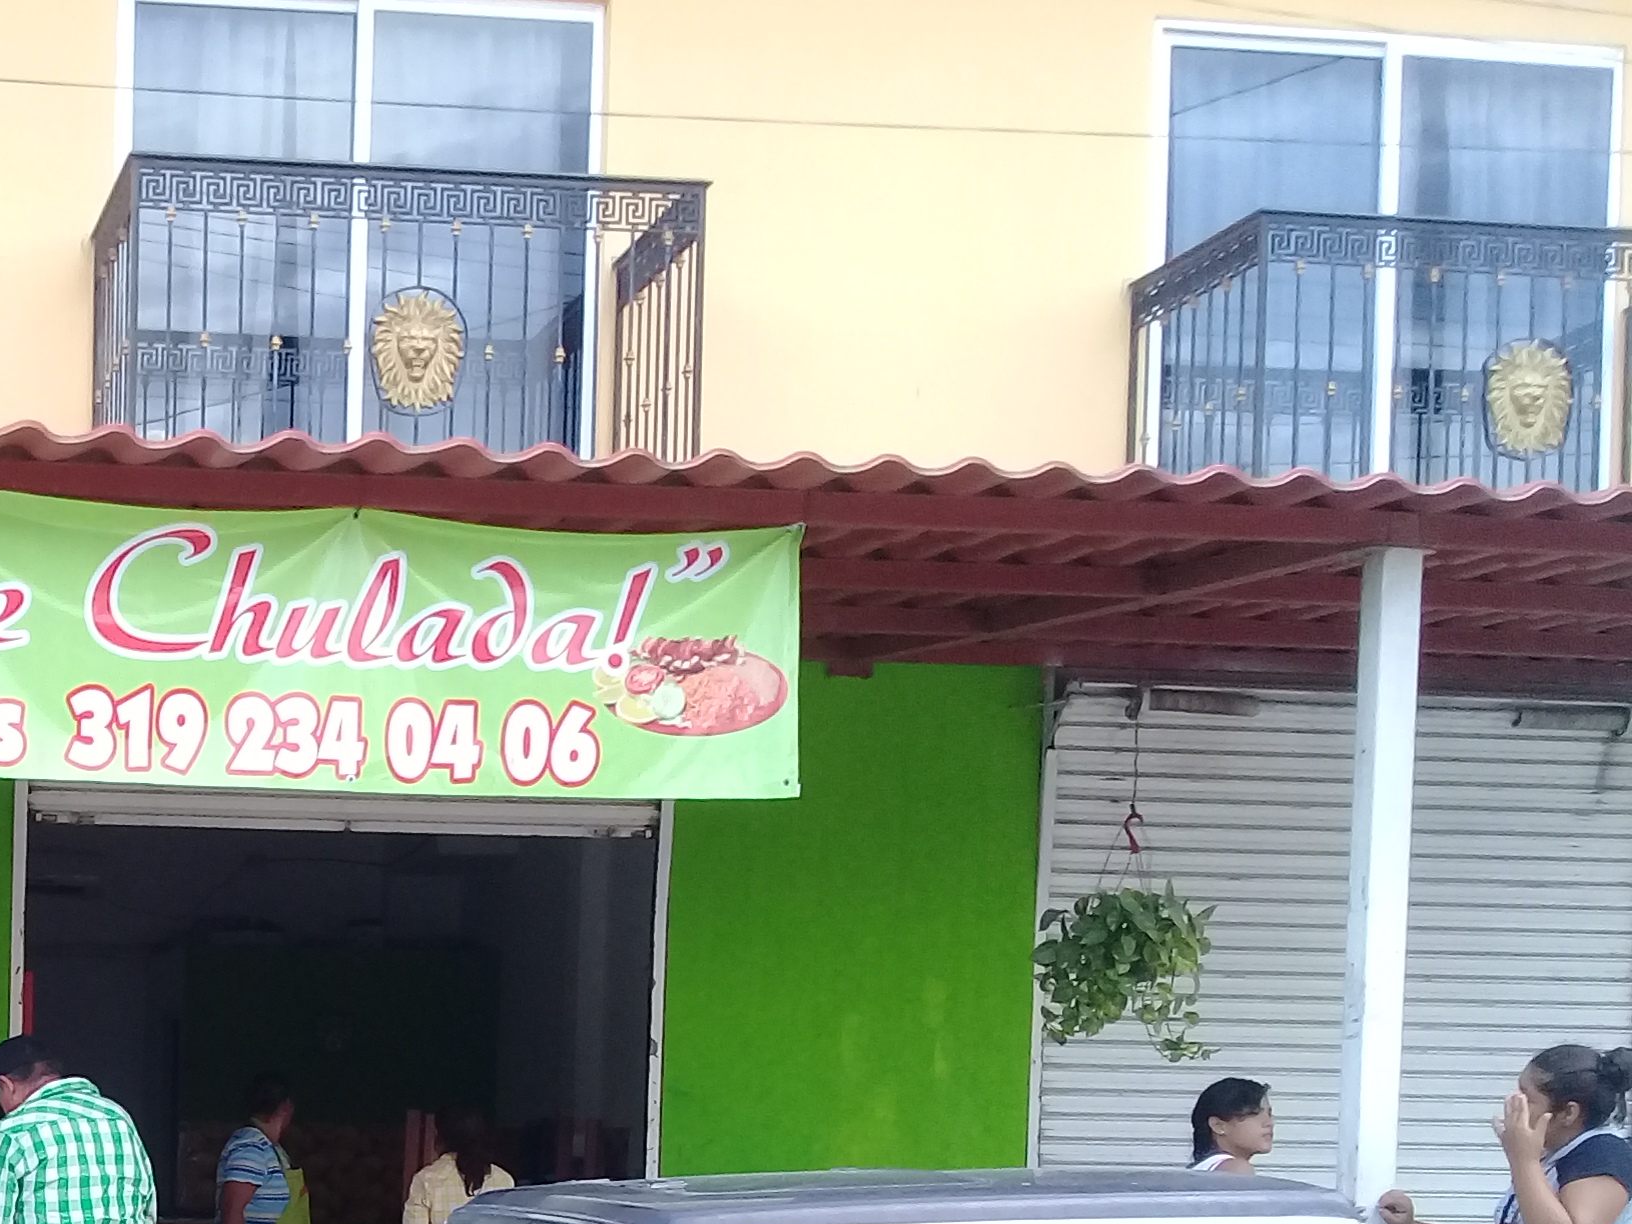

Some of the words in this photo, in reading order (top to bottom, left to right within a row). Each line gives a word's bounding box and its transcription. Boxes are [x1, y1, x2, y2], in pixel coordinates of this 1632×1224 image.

[65, 683, 208, 774] 319
[226, 691, 368, 780] 234
[385, 696, 483, 785] 04
[501, 699, 601, 788] 06
